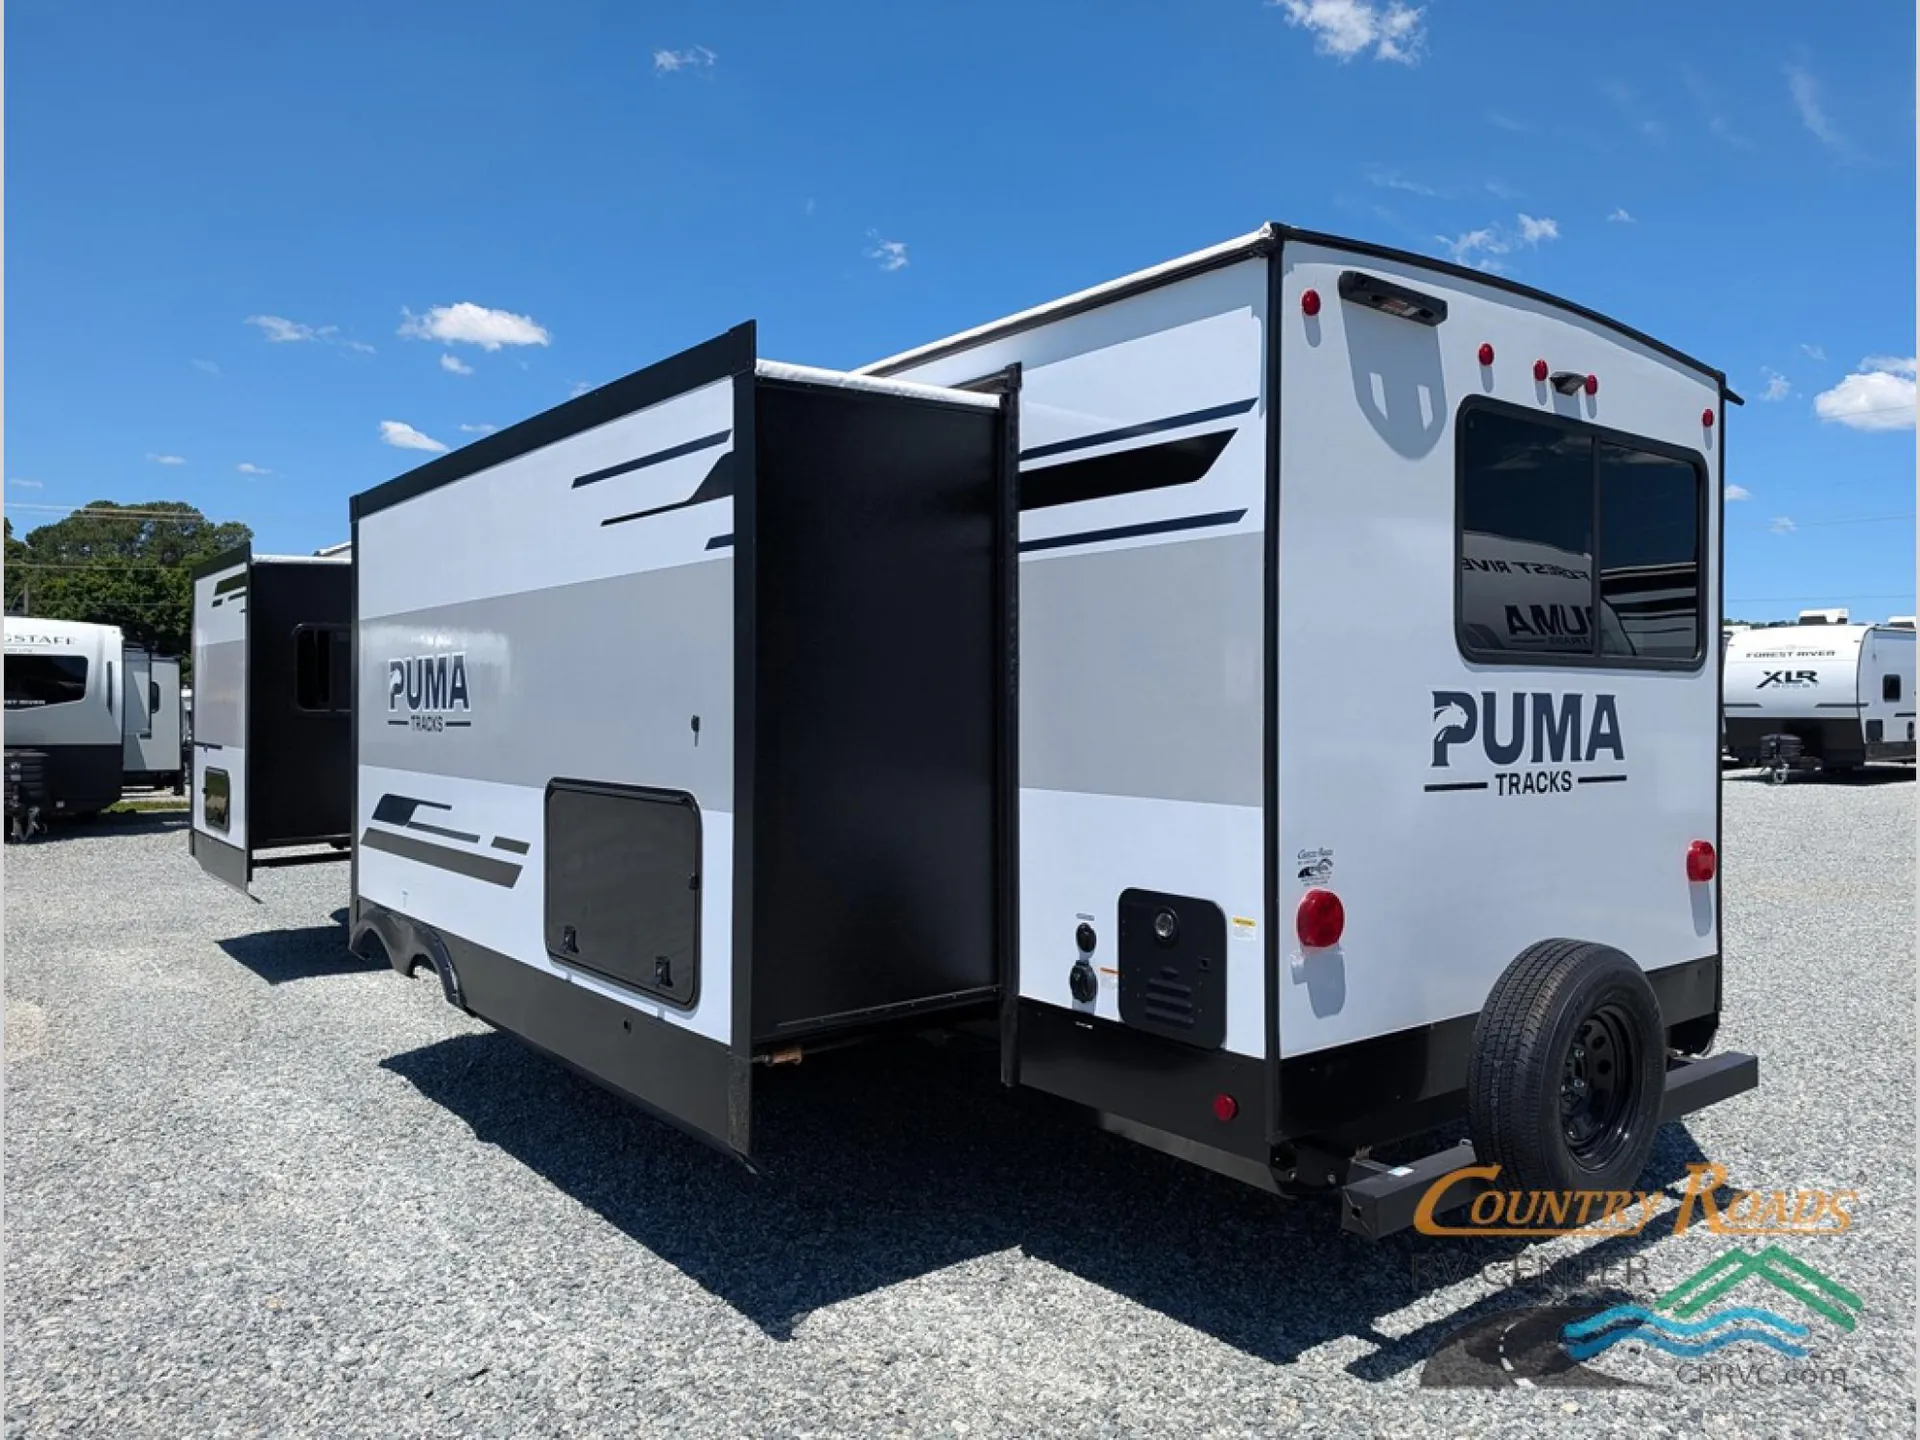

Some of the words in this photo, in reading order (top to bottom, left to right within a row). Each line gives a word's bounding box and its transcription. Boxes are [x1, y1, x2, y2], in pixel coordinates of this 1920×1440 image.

[388, 652, 471, 712] PUMA
[1755, 670, 1819, 690] XLR
[1431, 691, 1625, 767] PUMA
[1495, 770, 1573, 797] TRACKS
